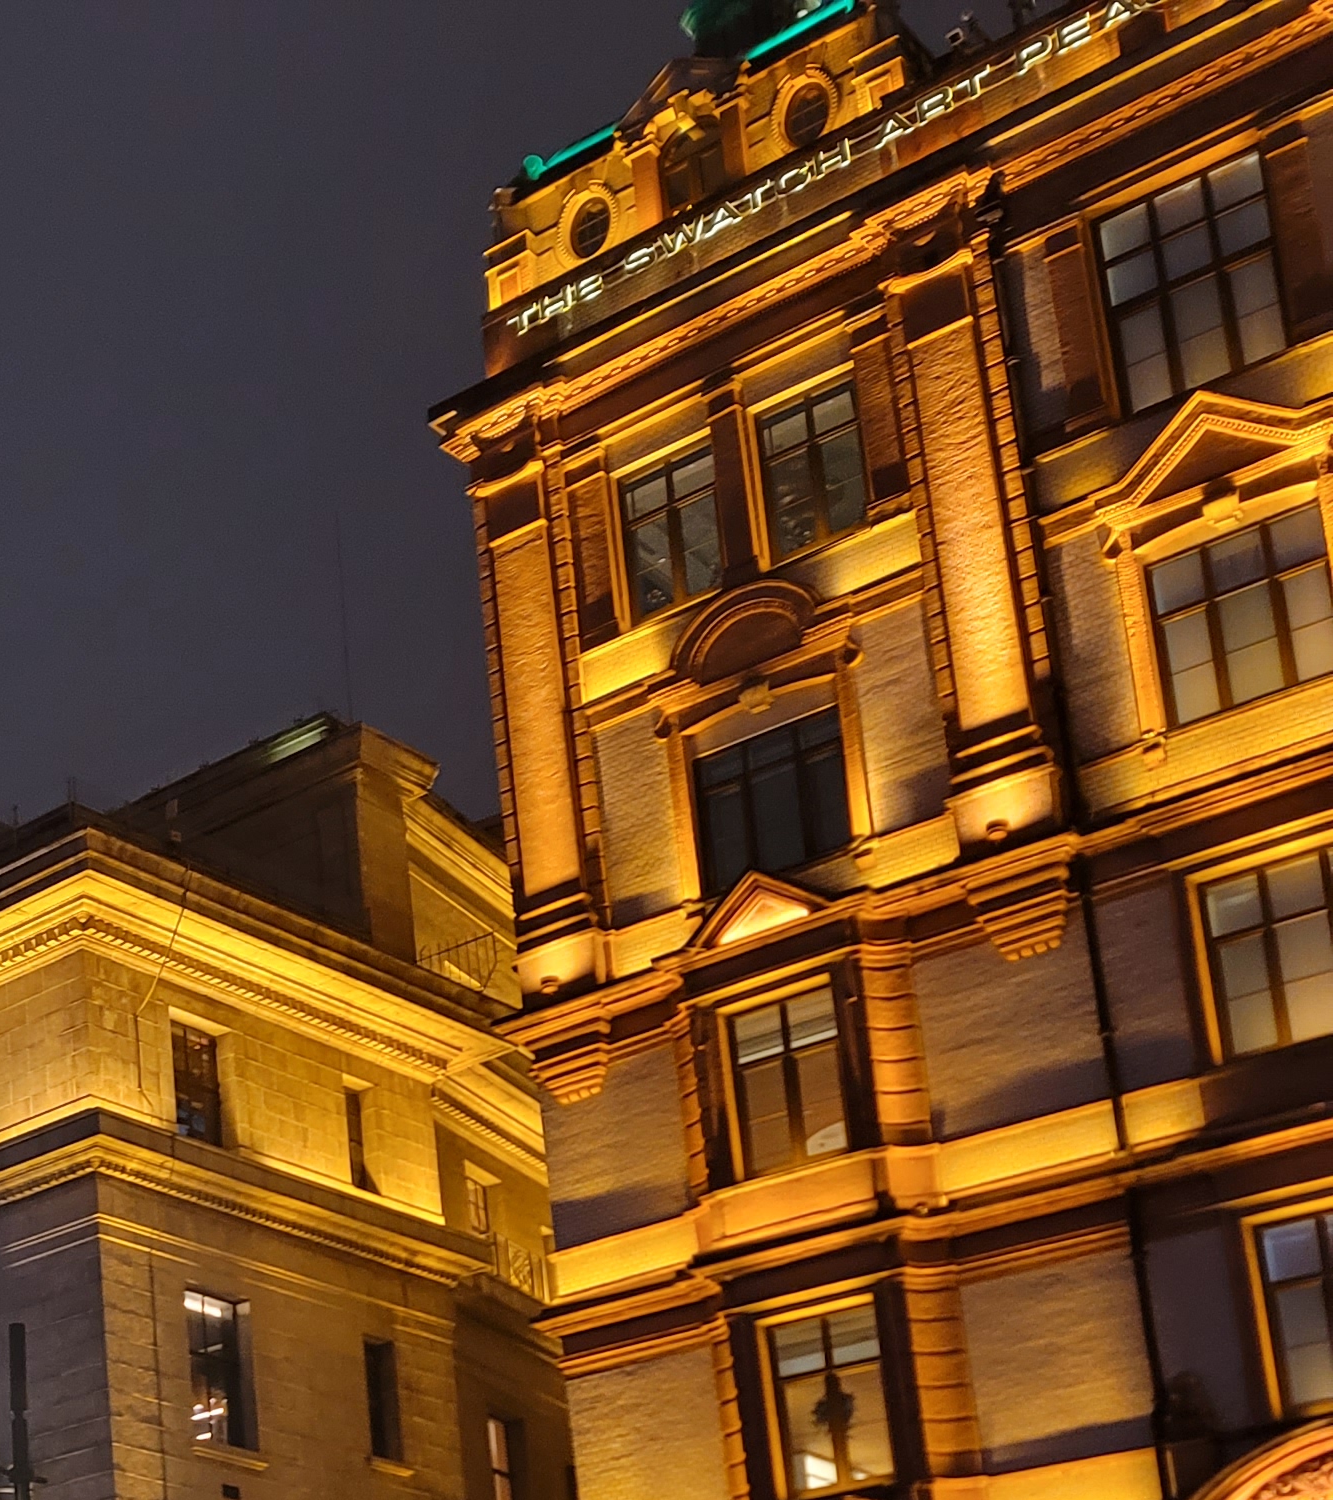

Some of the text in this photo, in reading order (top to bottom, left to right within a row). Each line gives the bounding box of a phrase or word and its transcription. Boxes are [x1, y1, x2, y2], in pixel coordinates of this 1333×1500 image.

[506, 0, 1157, 336] THE SWATCH ART PEA
